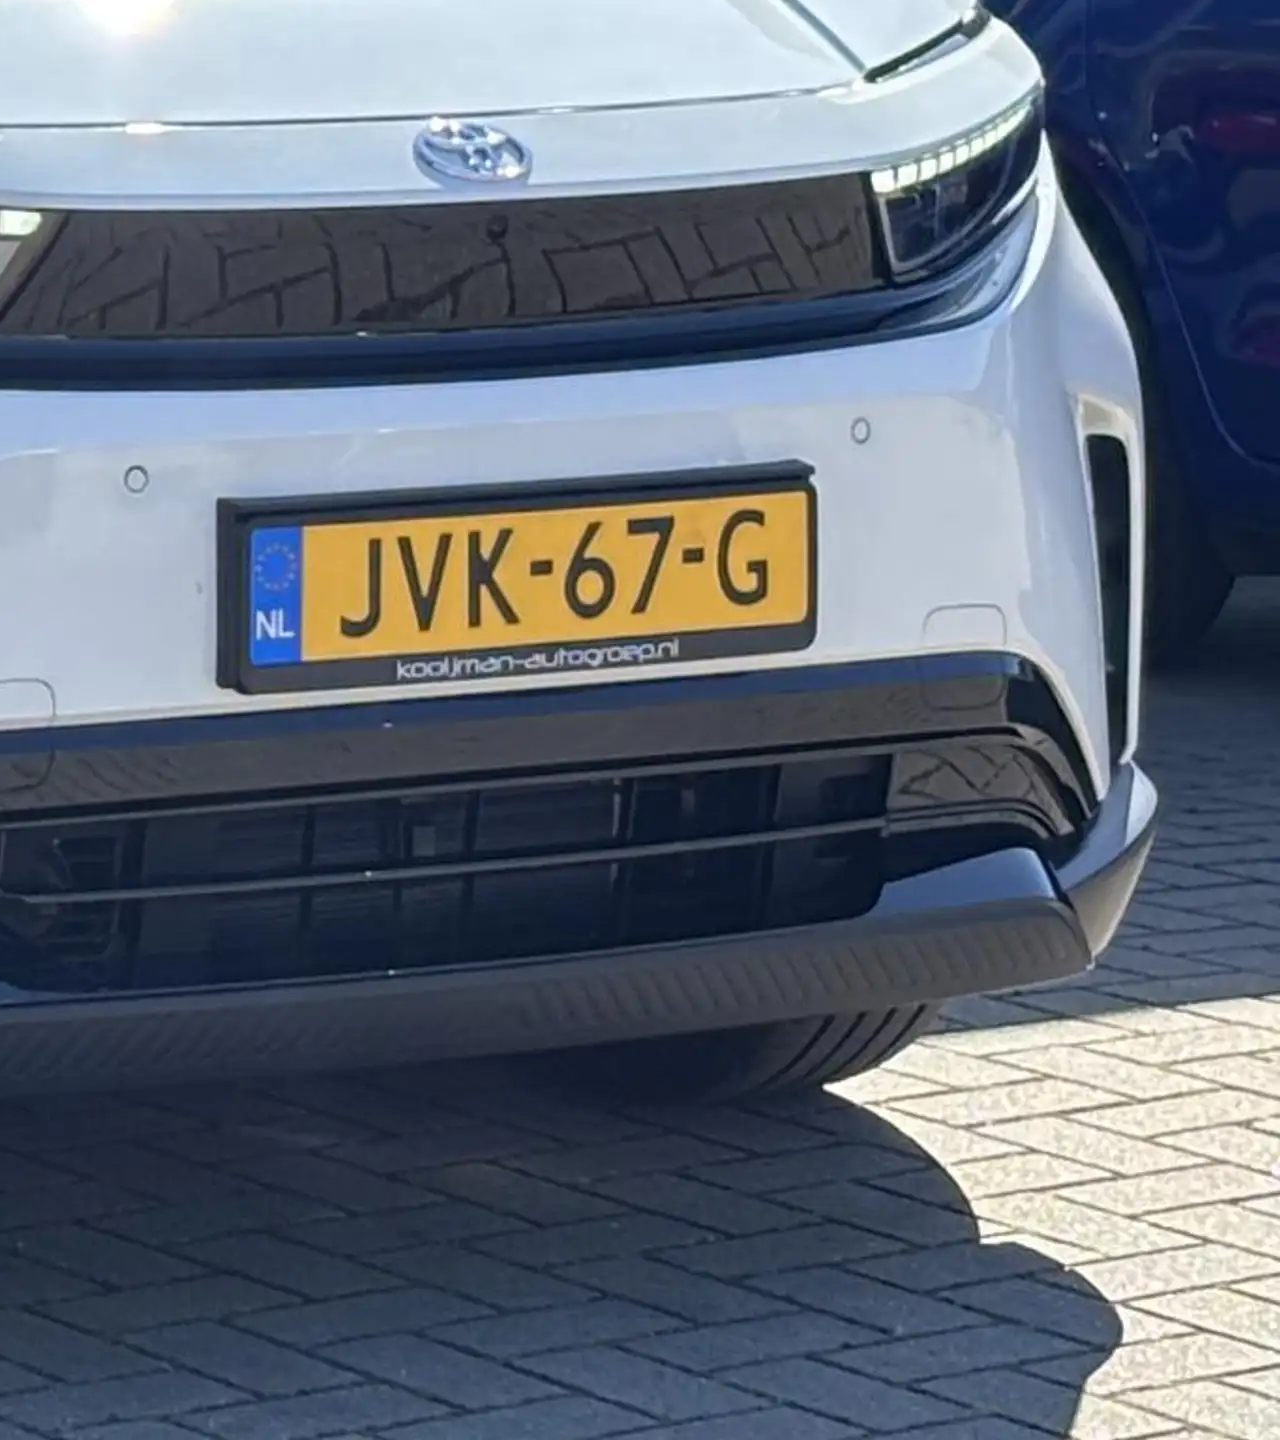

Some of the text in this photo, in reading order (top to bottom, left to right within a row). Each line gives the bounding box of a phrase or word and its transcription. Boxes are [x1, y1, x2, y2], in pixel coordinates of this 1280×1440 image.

[255, 508, 769, 640] NL JVK-67-G
[396, 637, 680, 682] kooijman-autogroep.nl
